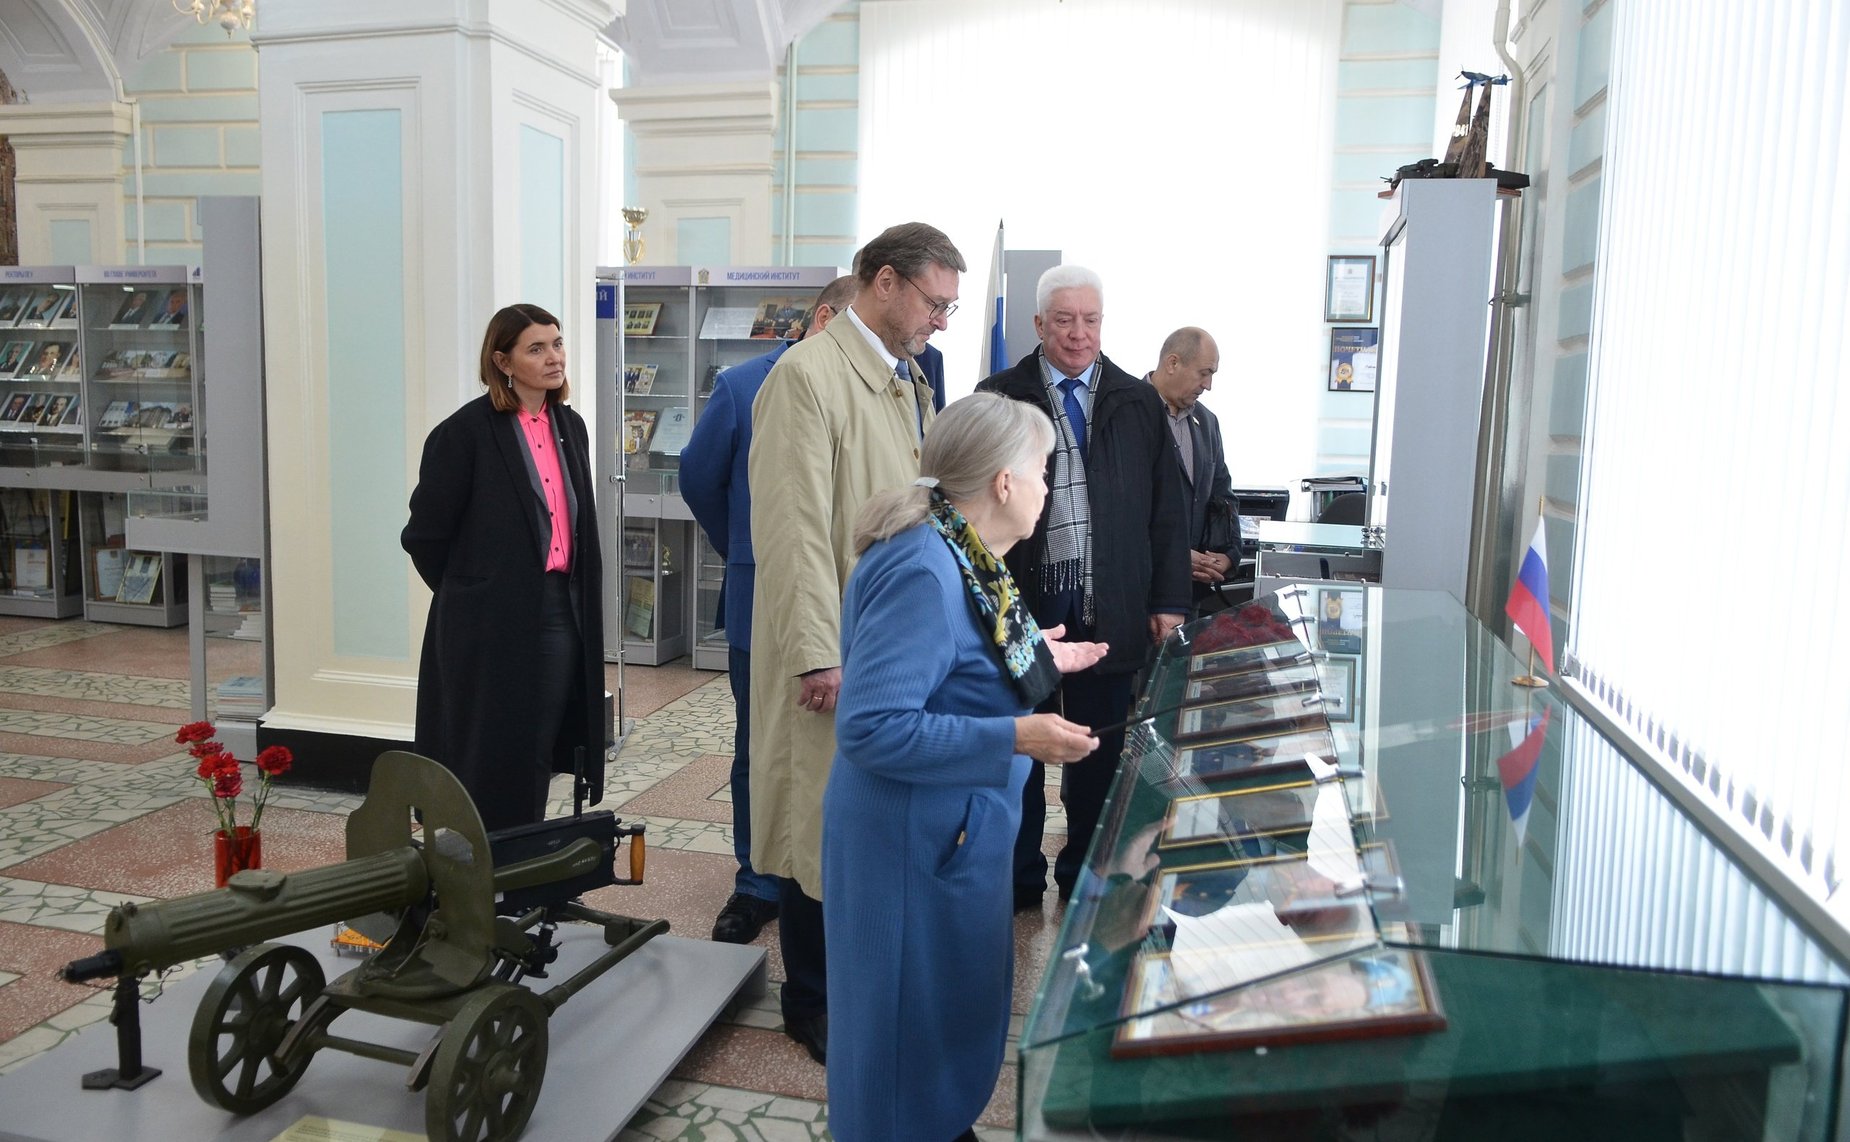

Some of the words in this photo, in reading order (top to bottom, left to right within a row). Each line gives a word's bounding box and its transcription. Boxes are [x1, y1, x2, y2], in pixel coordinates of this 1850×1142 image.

[627, 271, 656, 280] ИНСТИТУТ
[727, 270, 769, 281] МЕДИЦИНСКИЙ
[770, 271, 800, 281] ИНСТИТУТ
